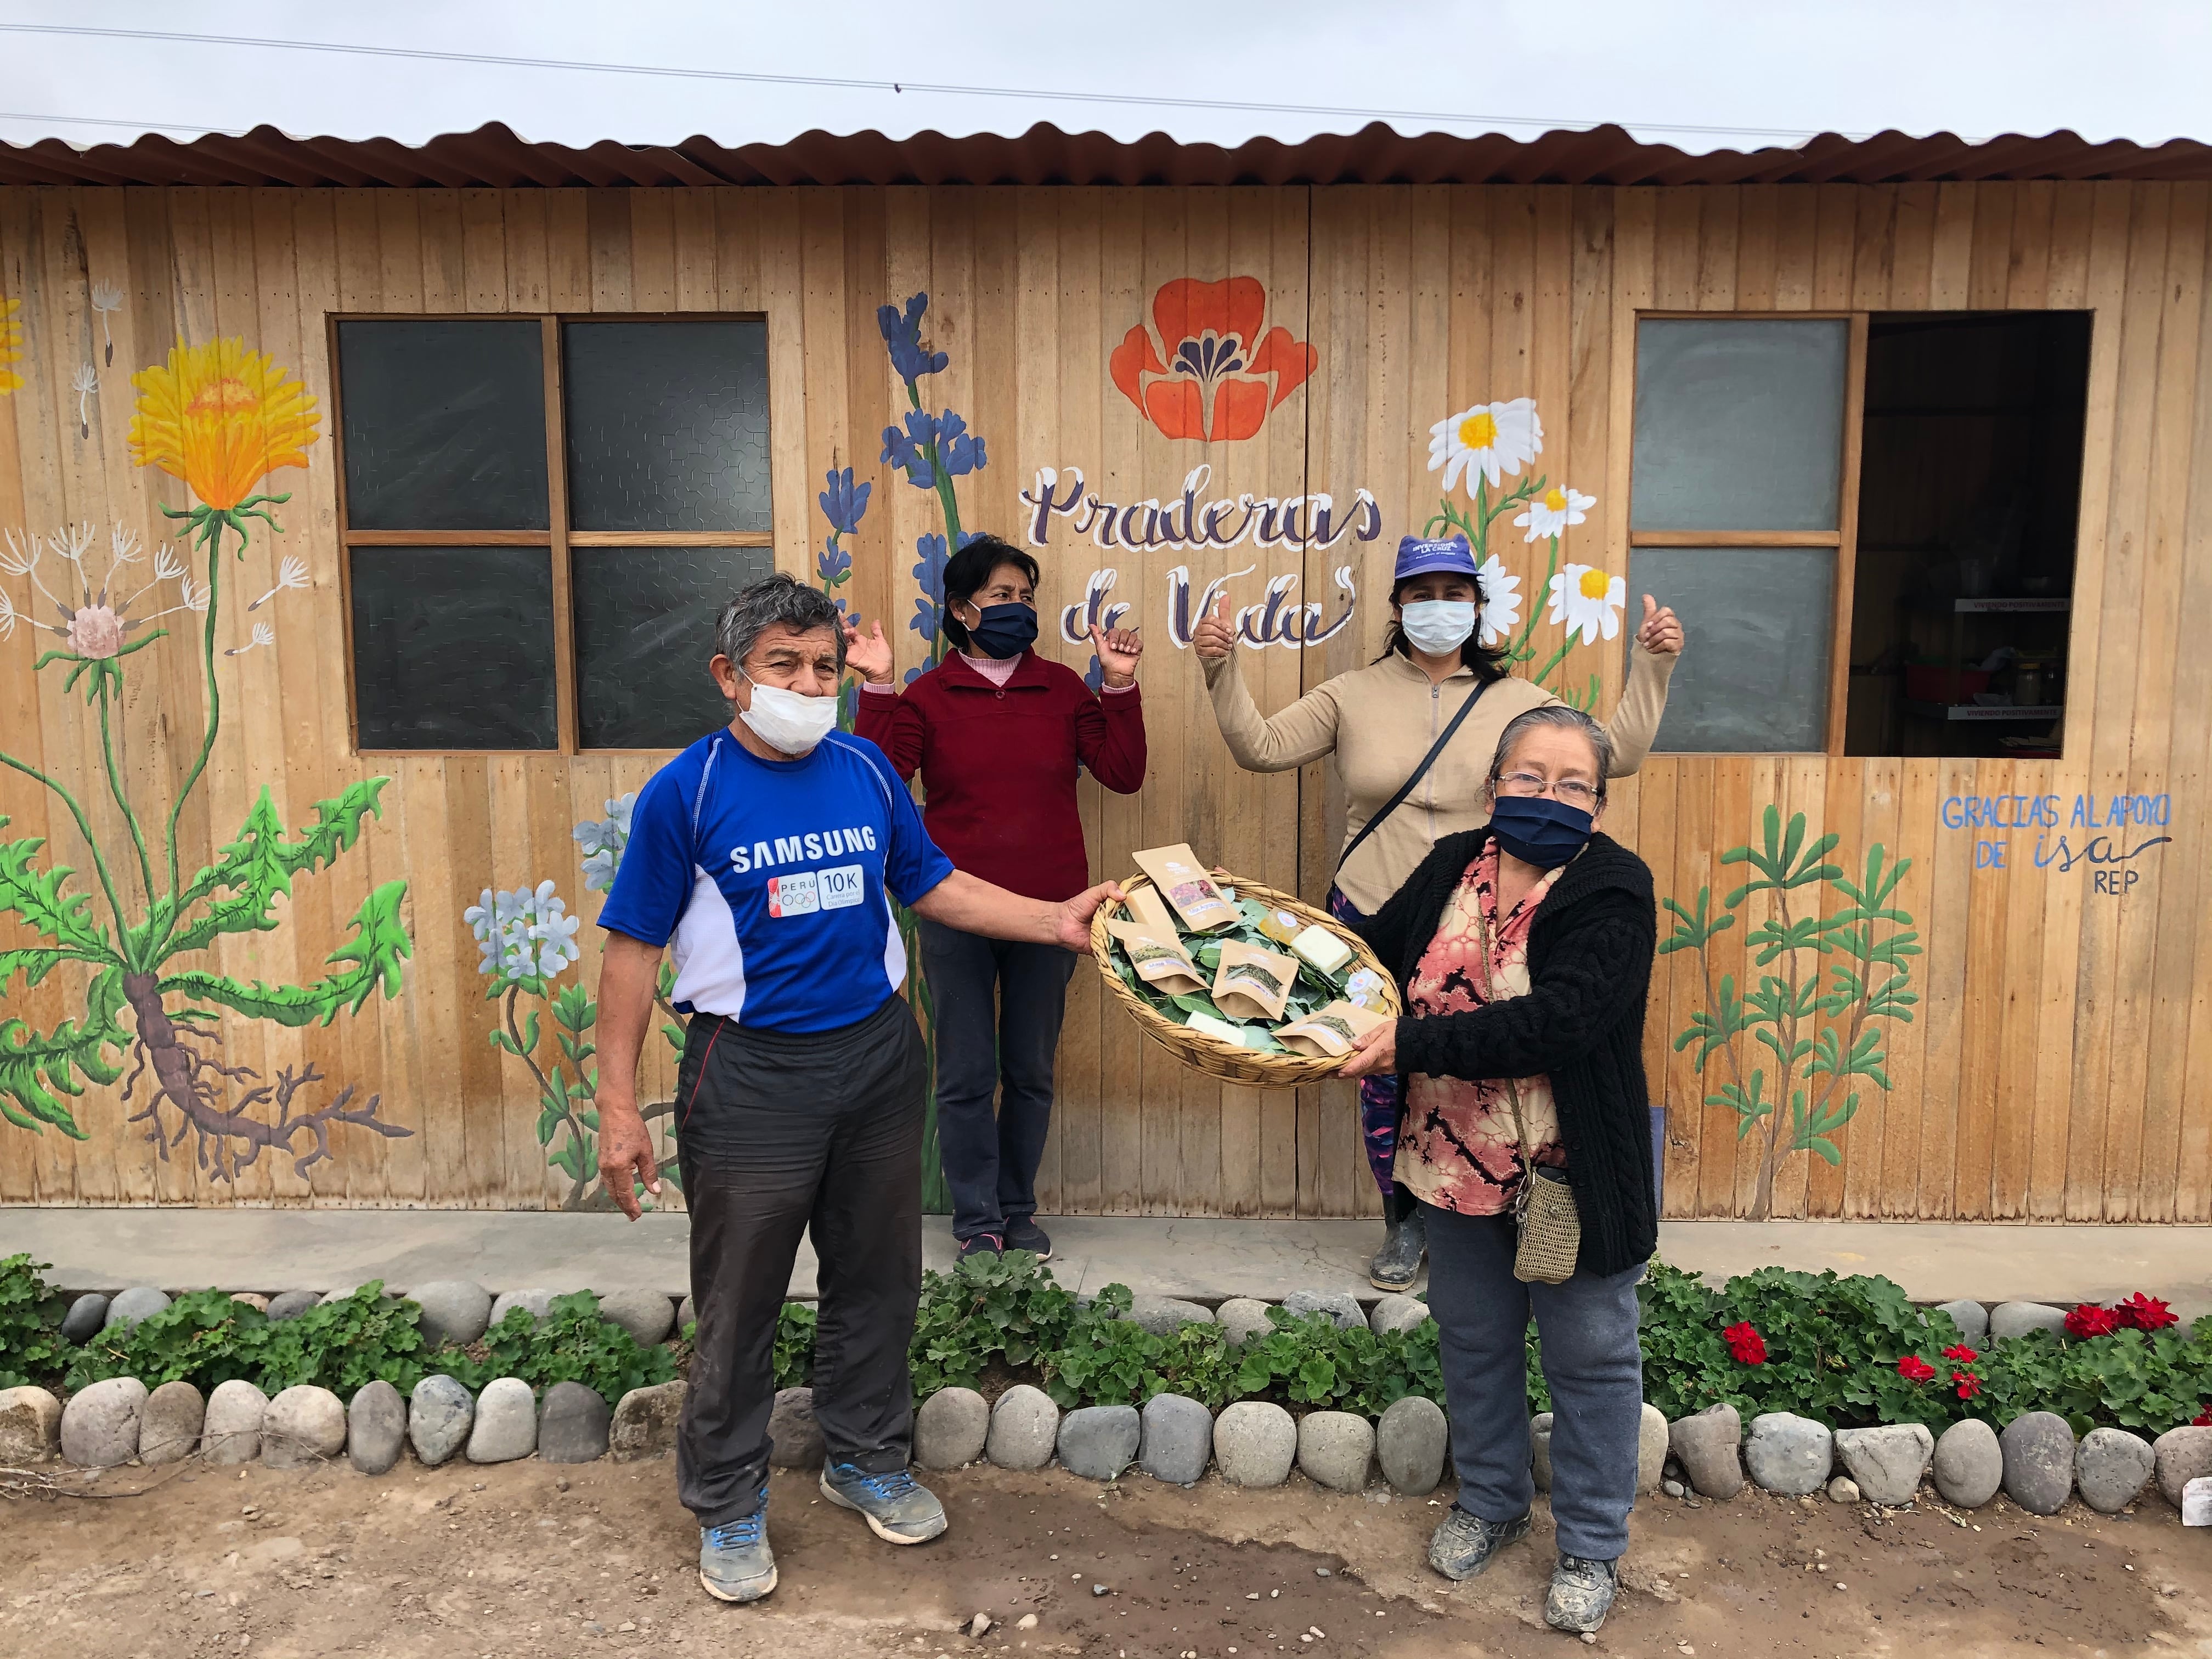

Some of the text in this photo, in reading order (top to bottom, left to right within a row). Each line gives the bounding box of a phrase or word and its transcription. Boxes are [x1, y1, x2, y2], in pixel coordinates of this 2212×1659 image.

[1019, 464, 1381, 552] Praderas
[1166, 564, 1356, 650] Vda
[1942, 794, 2171, 830] GRACIAS AL APOYO
[730, 825, 877, 874] SAMSUNG
[1976, 834, 2172, 872] DE isa
[781, 878, 815, 893] PERÚ
[2094, 870, 2139, 895] REP
